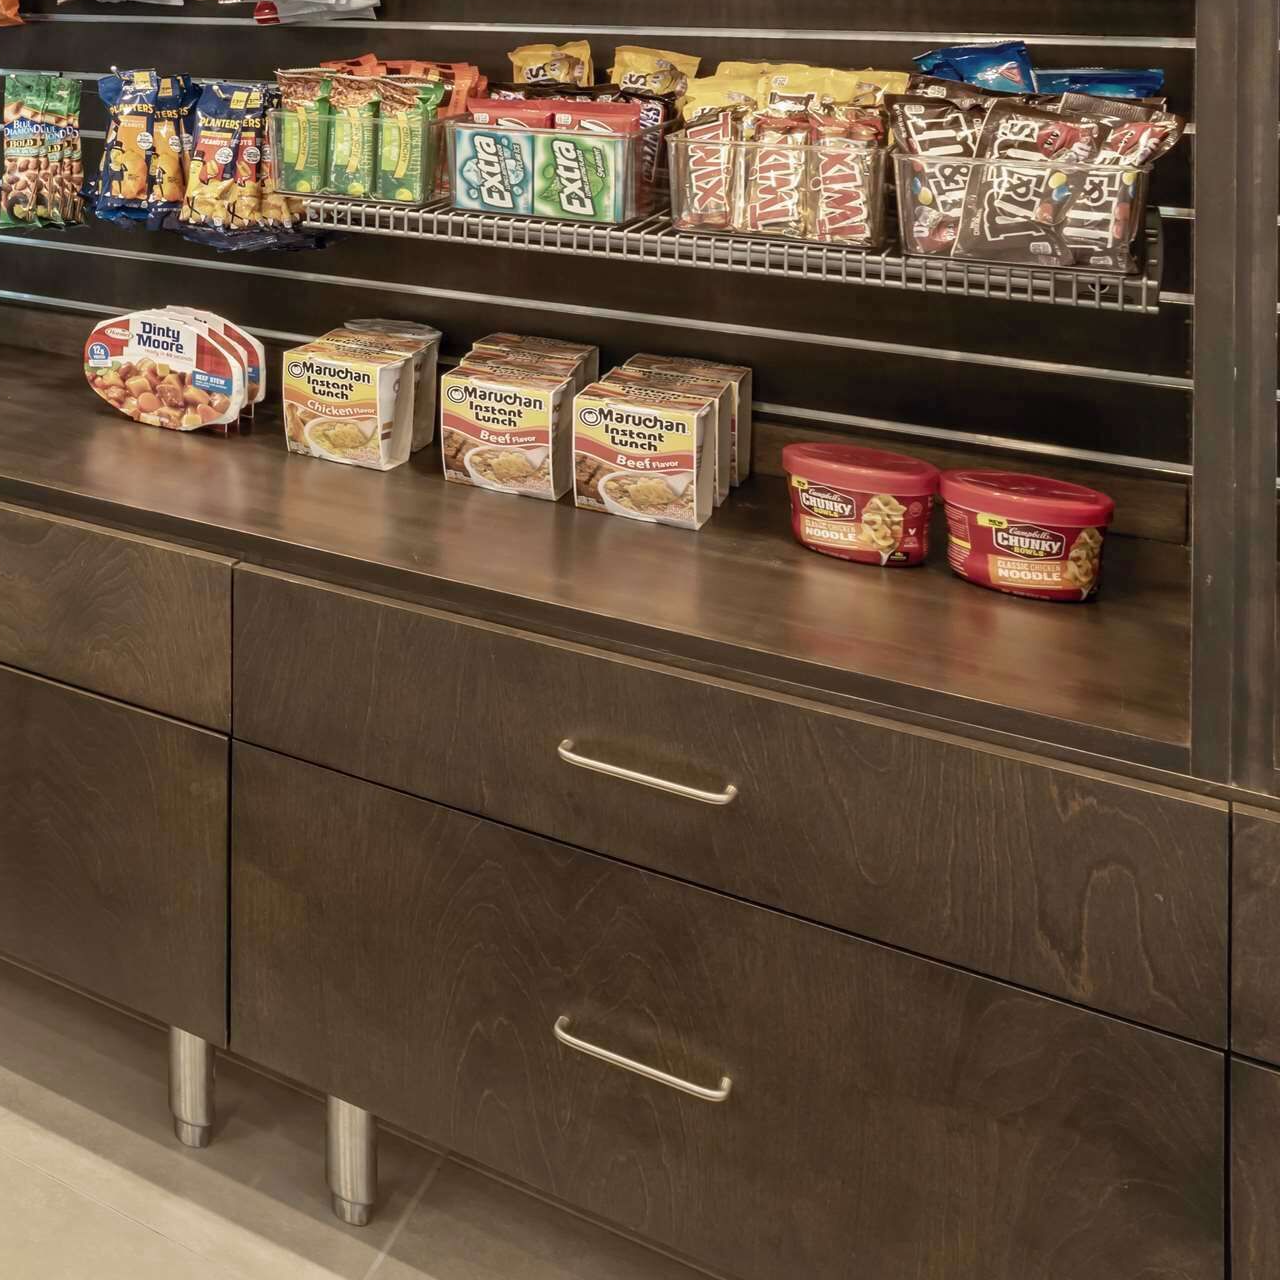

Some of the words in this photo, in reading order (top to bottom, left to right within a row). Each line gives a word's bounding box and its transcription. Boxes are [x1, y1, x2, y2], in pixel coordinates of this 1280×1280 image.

[109, 104, 154, 116] PLANTERS
[13, 120, 31, 129] BLUE
[199, 118, 239, 129] PLANTERS
[10, 139, 34, 147] BOLD
[473, 134, 514, 208] Extra
[552, 140, 595, 216] Extra
[140, 321, 181, 343] Dinty
[136, 332, 184, 354] Moore
[302, 360, 371, 385] Maruchan
[306, 375, 354, 392] Instant
[311, 386, 349, 401] Lunch
[464, 385, 544, 410] Maruchan
[307, 399, 353, 416] Chicken
[469, 401, 523, 419] Instant
[475, 411, 517, 428] Lunch
[598, 407, 687, 434] Maruchan
[479, 429, 512, 444] Beef
[512, 435, 536, 443] Flavor
[604, 424, 664, 443] Instant
[610, 435, 658, 452] Lunch
[616, 454, 651, 469] Beef
[652, 460, 679, 469] Flavor
[801, 492, 853, 515] CHUNKY
[805, 526, 857, 542] NOODLE
[997, 532, 1062, 554] CHUNKY
[998, 568, 1062, 582] NOODLE
